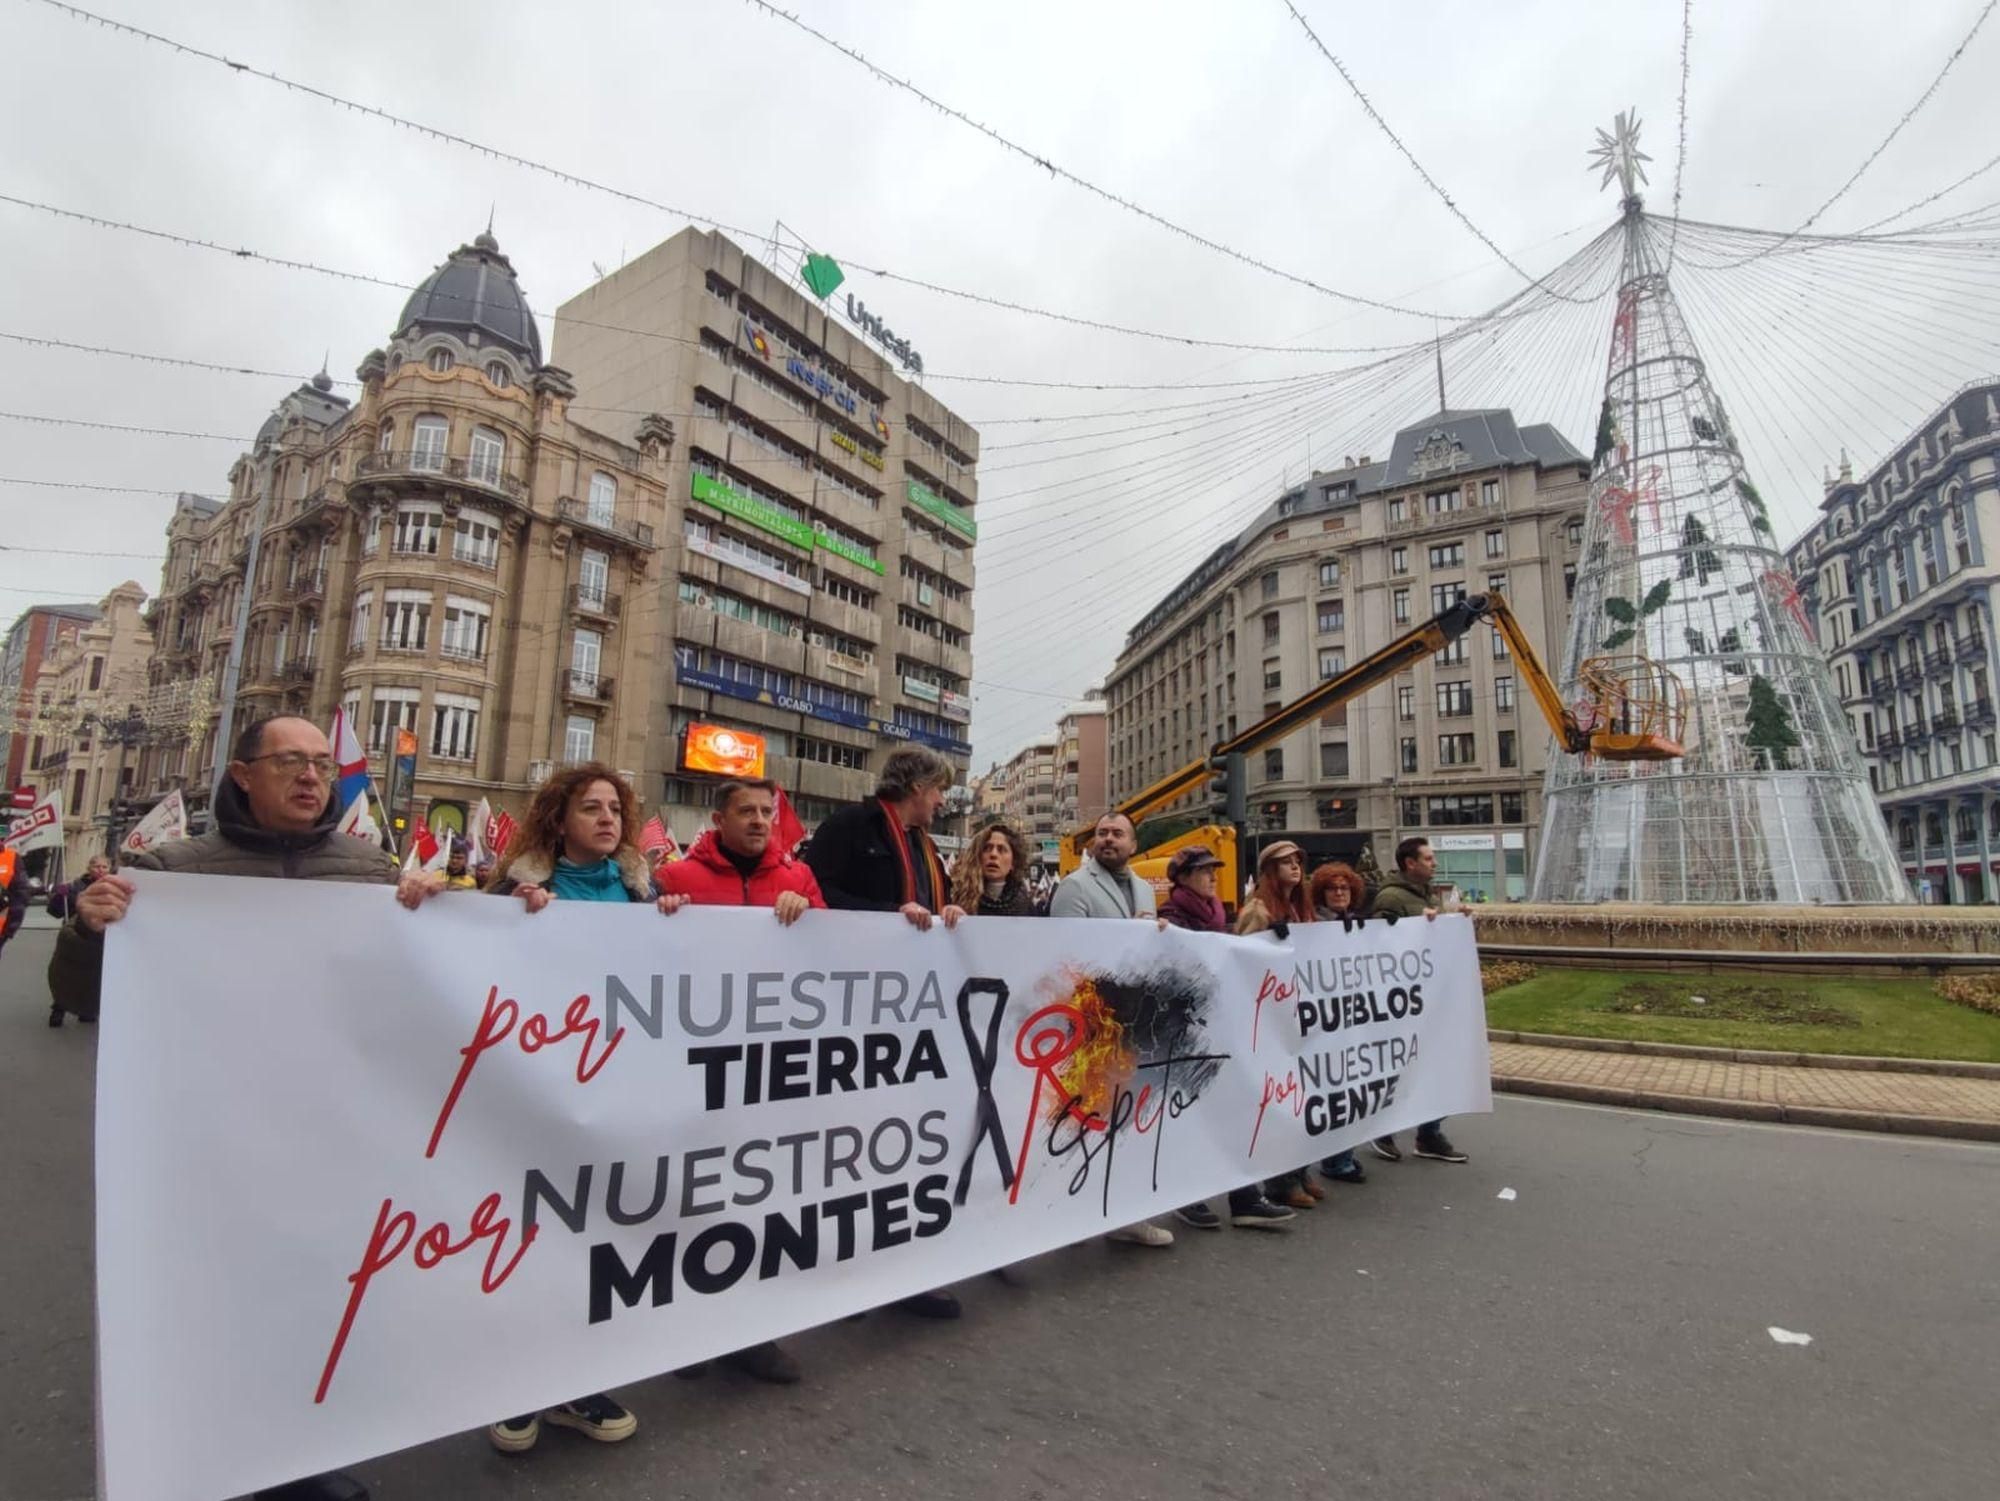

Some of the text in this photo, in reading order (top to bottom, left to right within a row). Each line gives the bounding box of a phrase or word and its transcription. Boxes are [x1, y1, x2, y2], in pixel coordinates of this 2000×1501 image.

[848, 293, 924, 372] Unicaja
[778, 695, 813, 713] OCASO
[883, 723, 911, 738] OCASO
[1295, 949, 1434, 994] NUESTROS
[1298, 984, 1424, 1038] PUEBLOS
[425, 969, 948, 1158] por NUESTRA
[687, 1029, 949, 1111] TIERRA
[1249, 1033, 1418, 1158] por NUESTRA
[1304, 1074, 1400, 1136] GENTE
[314, 1109, 950, 1404] por NUESTROS
[588, 1174, 953, 1325] MONTES
